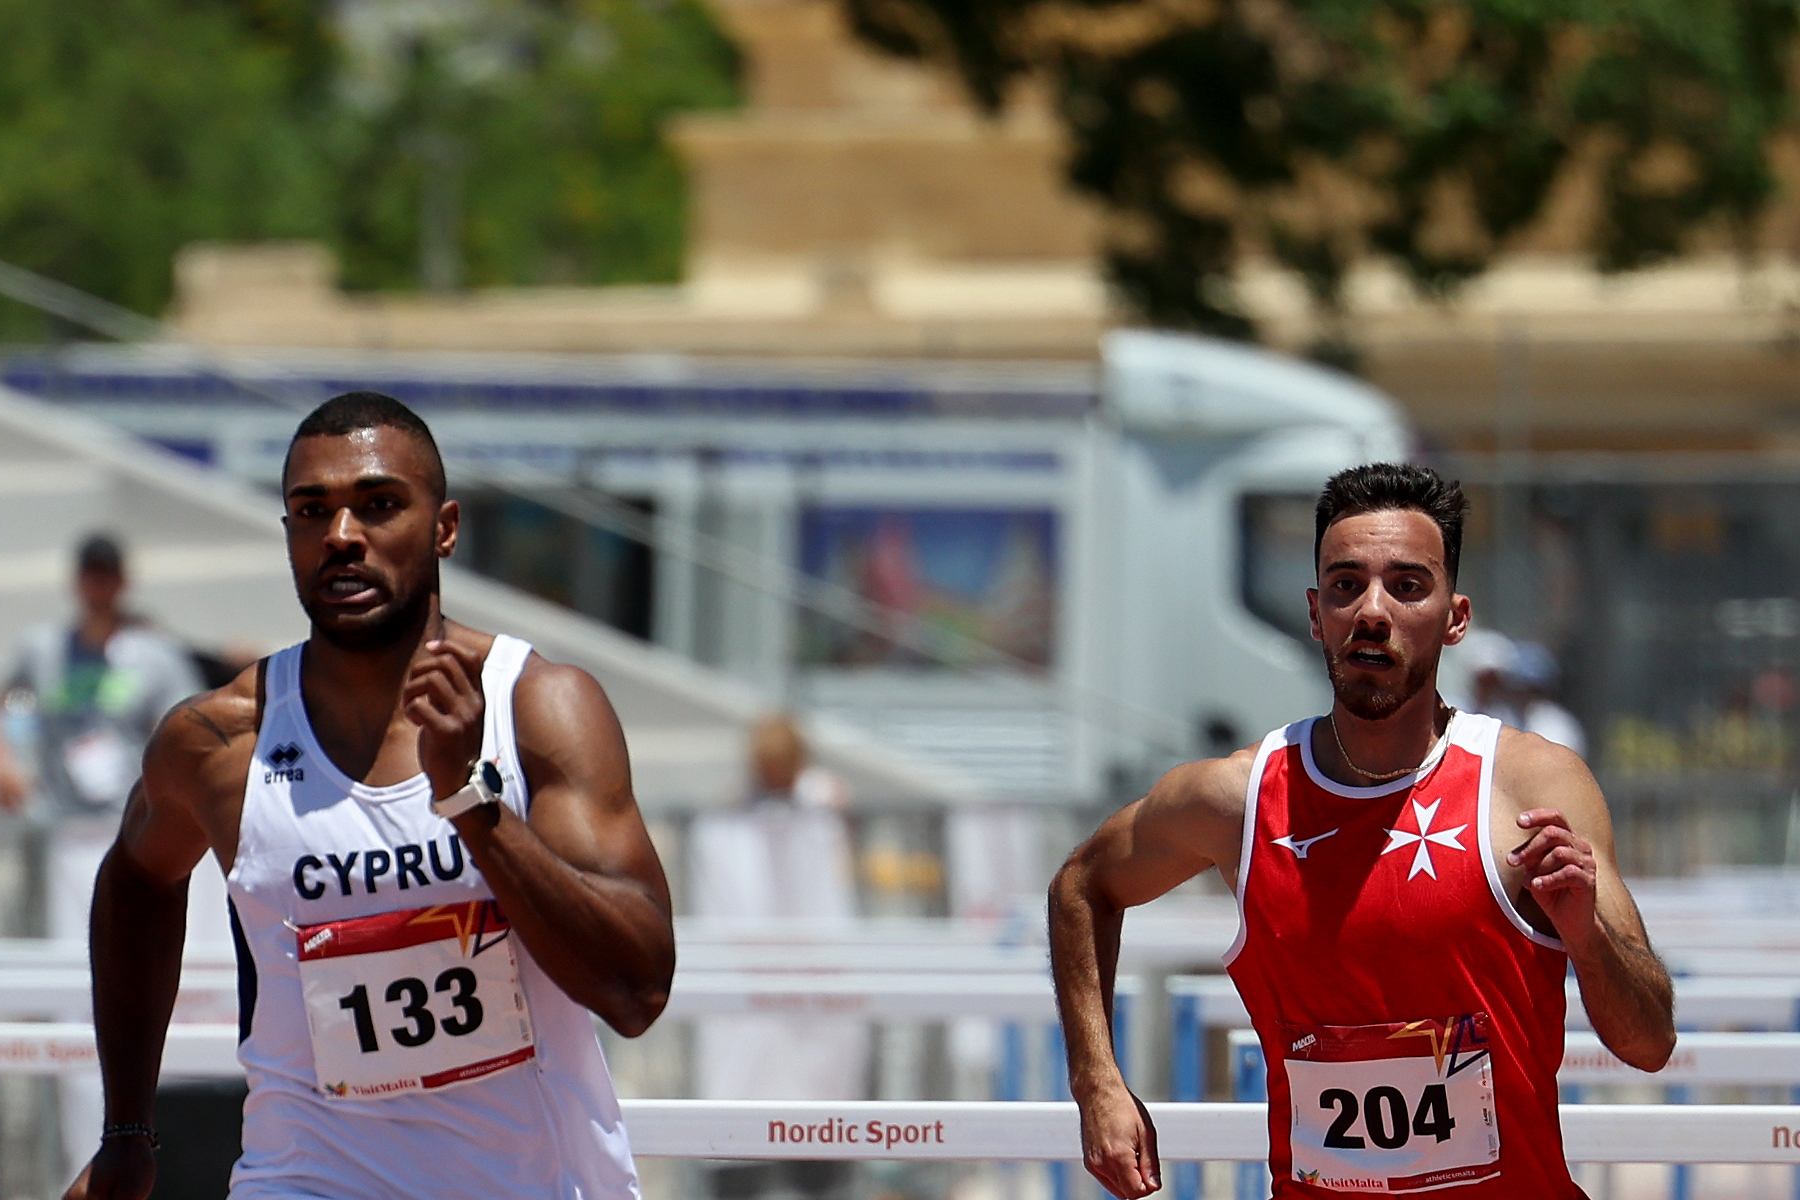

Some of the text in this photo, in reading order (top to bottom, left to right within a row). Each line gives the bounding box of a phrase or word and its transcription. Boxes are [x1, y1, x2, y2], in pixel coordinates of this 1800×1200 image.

[292, 834, 478, 900] CYPRU
[338, 966, 484, 1054] 133
[1292, 1033, 1317, 1052] MALTA
[352, 1079, 417, 1096] VisitMalta
[1319, 1083, 1456, 1150] 204
[865, 1119, 945, 1150] Sport
[1321, 1177, 1384, 1189] VisitMalta
